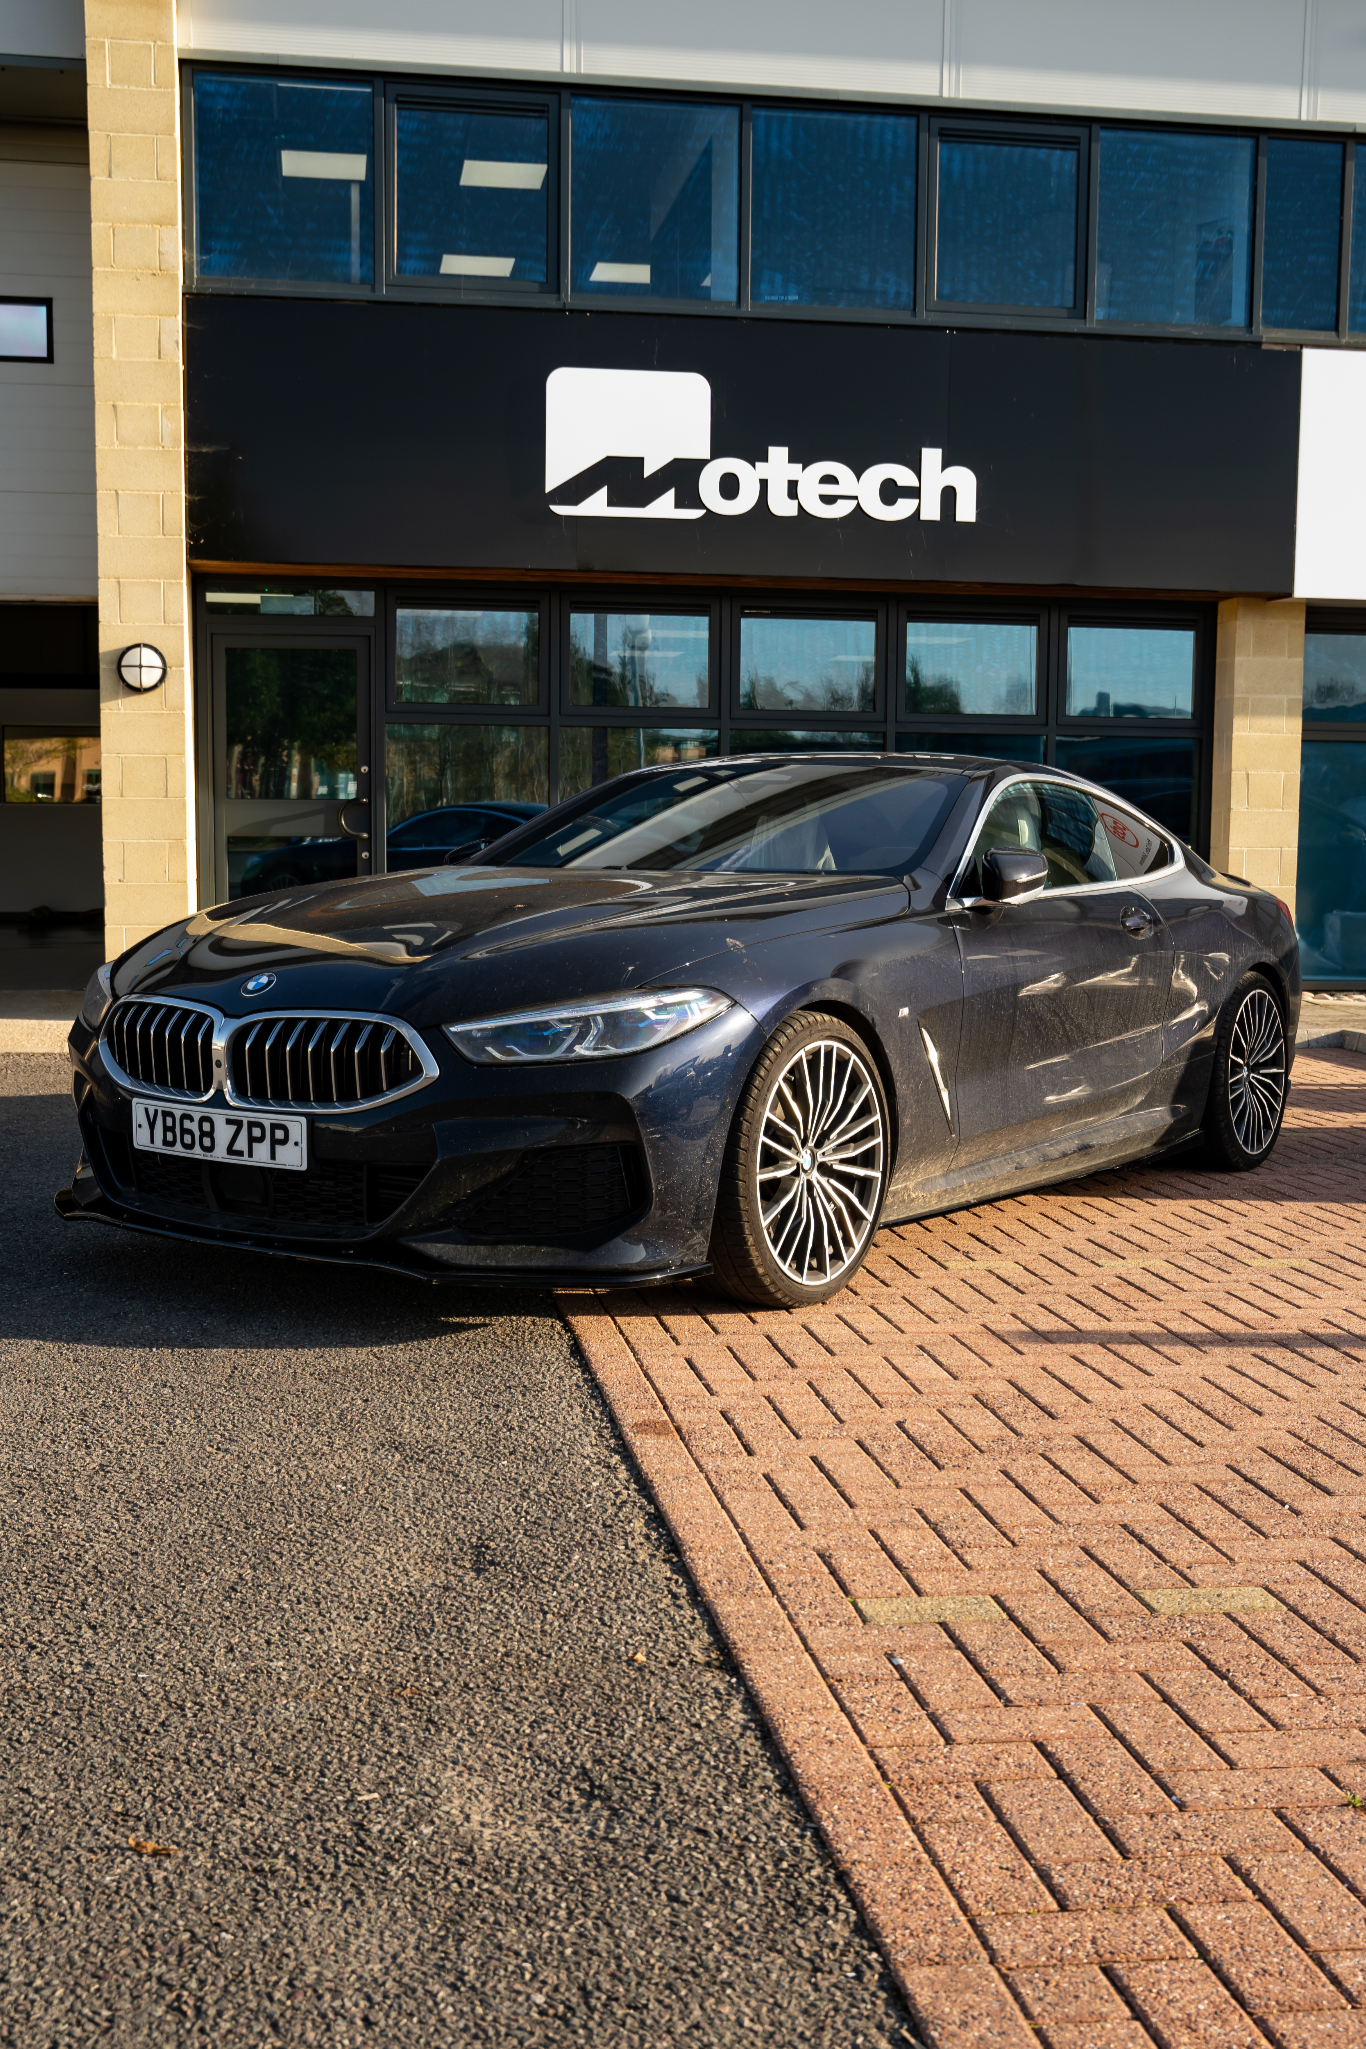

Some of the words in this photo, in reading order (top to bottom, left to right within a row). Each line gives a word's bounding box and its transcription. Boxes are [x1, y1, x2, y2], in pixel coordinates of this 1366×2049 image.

[546, 442, 977, 522] Motech
[144, 1107, 216, 1153] YB68
[225, 1118, 290, 1161] ZPP
